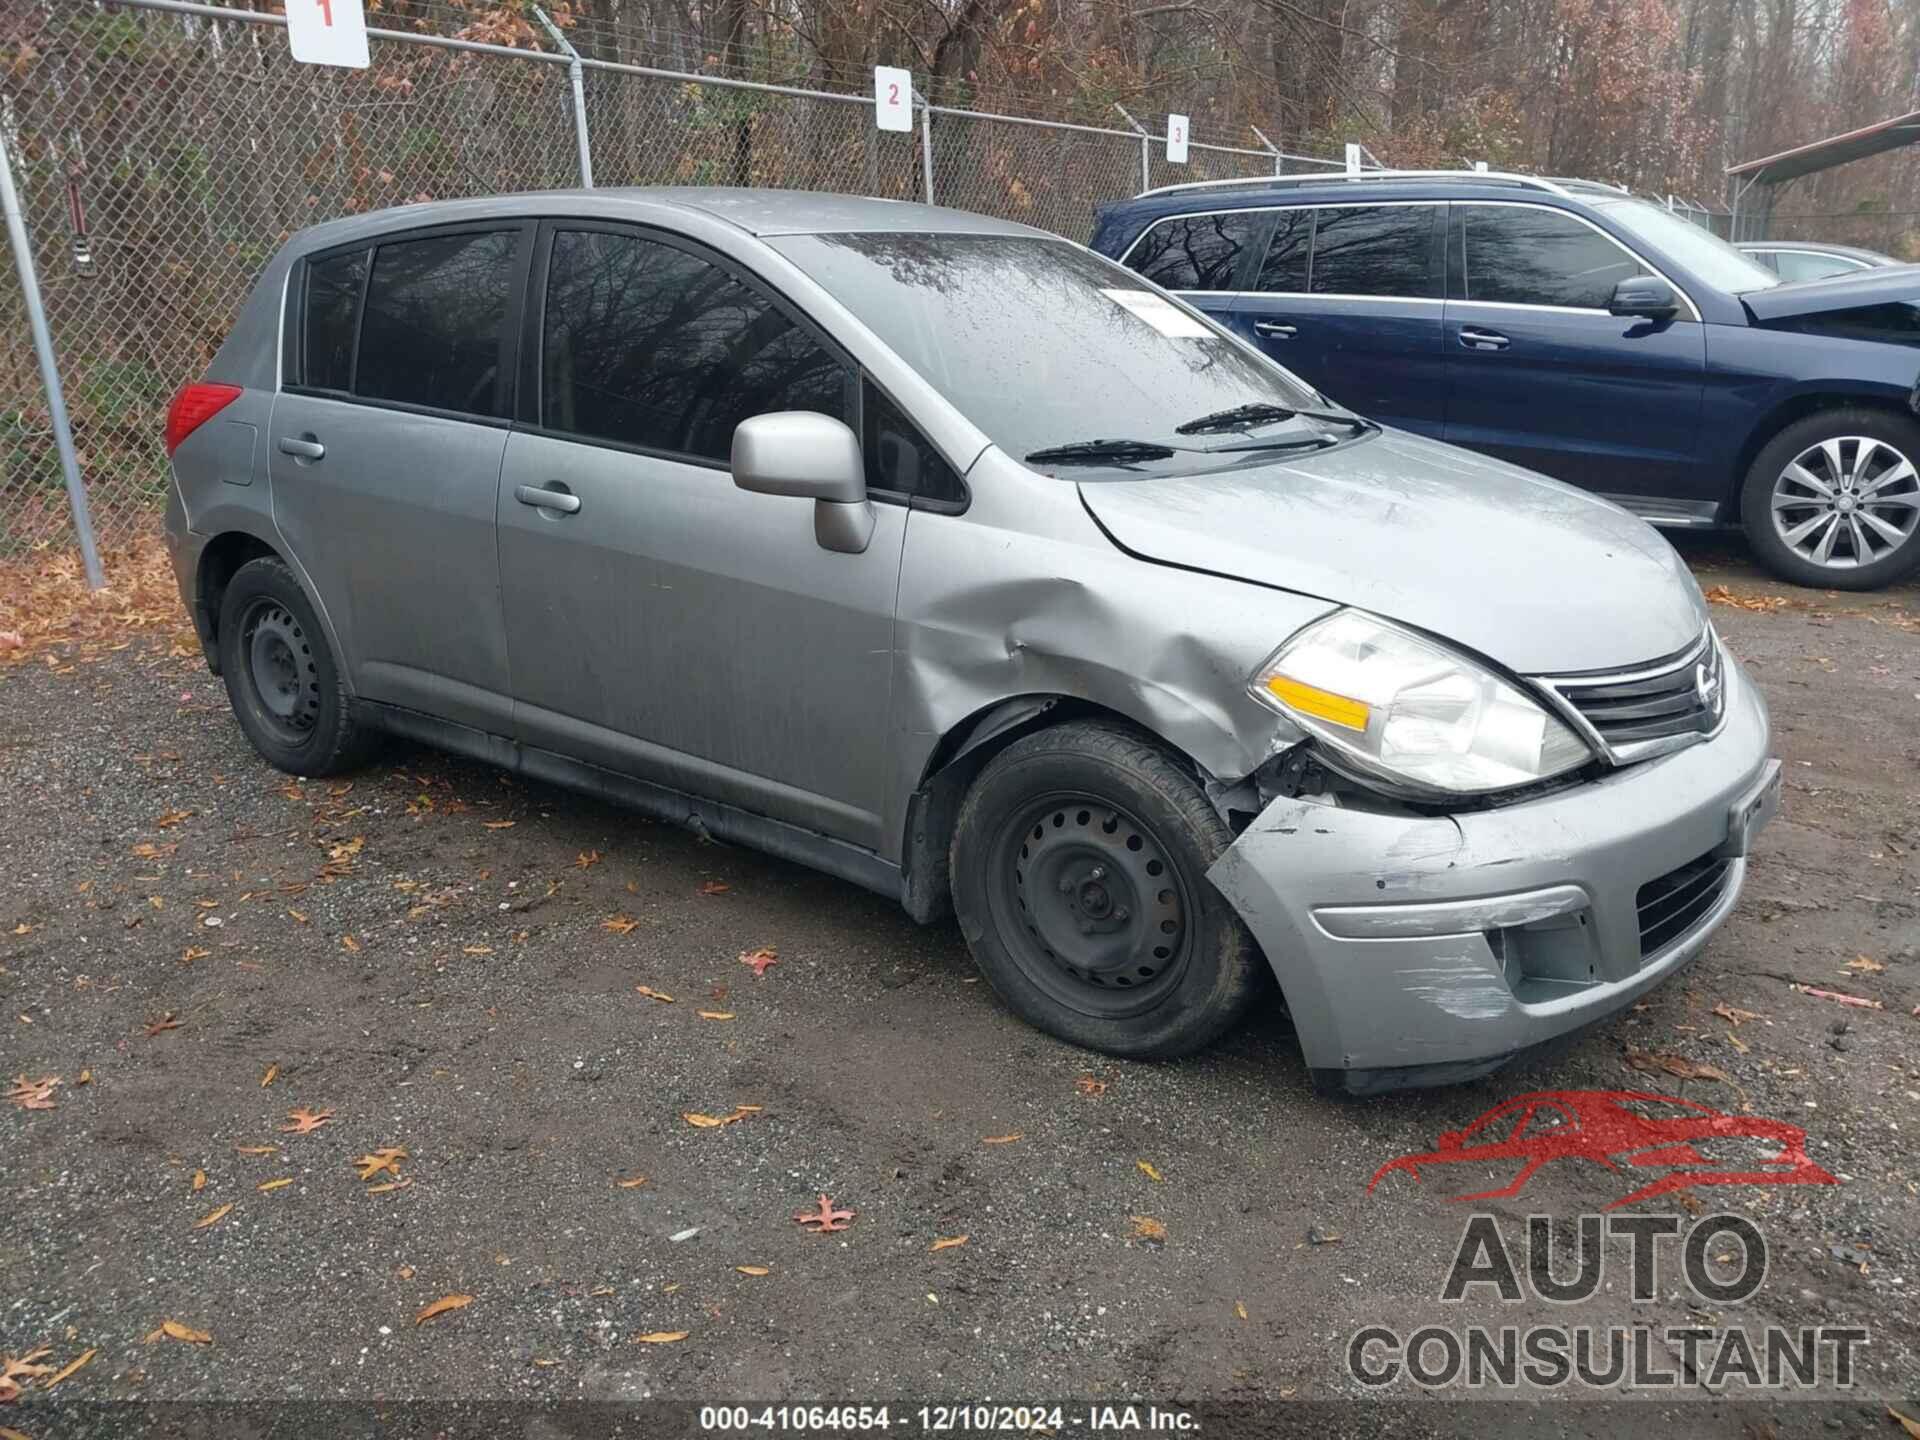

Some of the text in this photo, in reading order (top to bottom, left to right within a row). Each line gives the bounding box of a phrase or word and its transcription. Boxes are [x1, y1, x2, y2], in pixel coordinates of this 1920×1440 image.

[316, 0, 332, 27] 1
[888, 83, 900, 105] 2
[1175, 126, 1182, 144] 3
